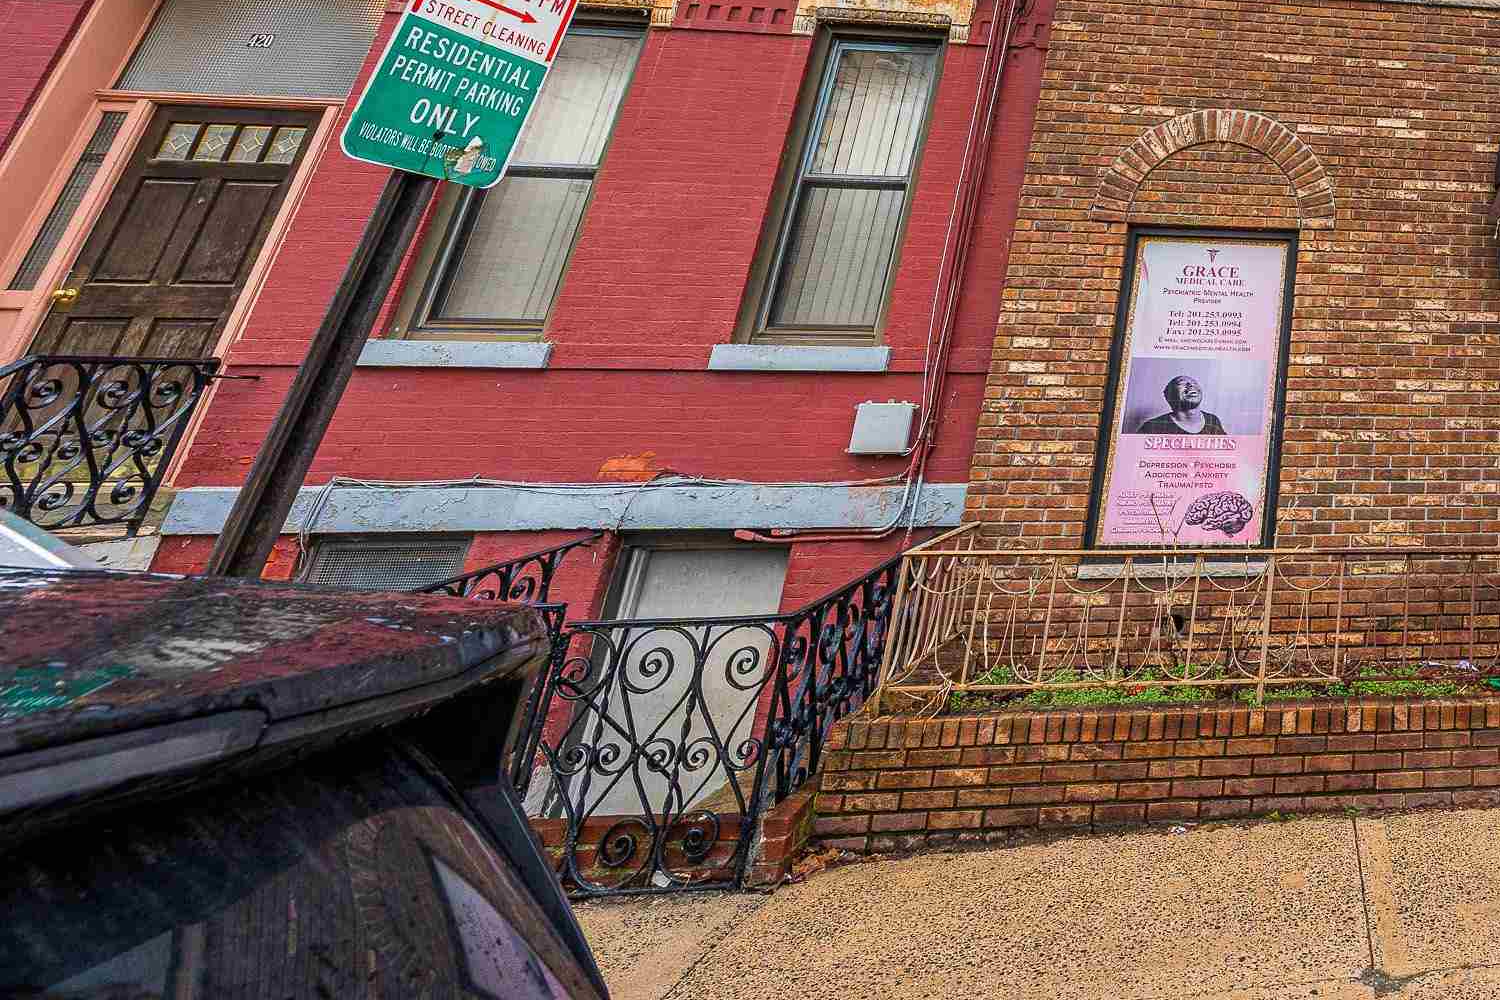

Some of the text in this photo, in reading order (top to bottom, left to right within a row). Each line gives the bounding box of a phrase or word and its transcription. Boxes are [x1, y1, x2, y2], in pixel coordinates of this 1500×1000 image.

[250, 34, 273, 48] 420
[425, 0, 547, 56] STREET CLEANING
[404, 27, 531, 91] RESIDENTIAL
[389, 55, 524, 117] PERMIT PARKING
[409, 98, 481, 138] ONLY
[358, 119, 402, 147] VIOLATORS
[400, 133, 416, 152] WILL
[418, 138, 433, 154] BE
[1183, 265, 1240, 278] GRACE
[1144, 437, 1237, 450] SPECIALTIES
[1139, 460, 1188, 469] DEPRESSION
